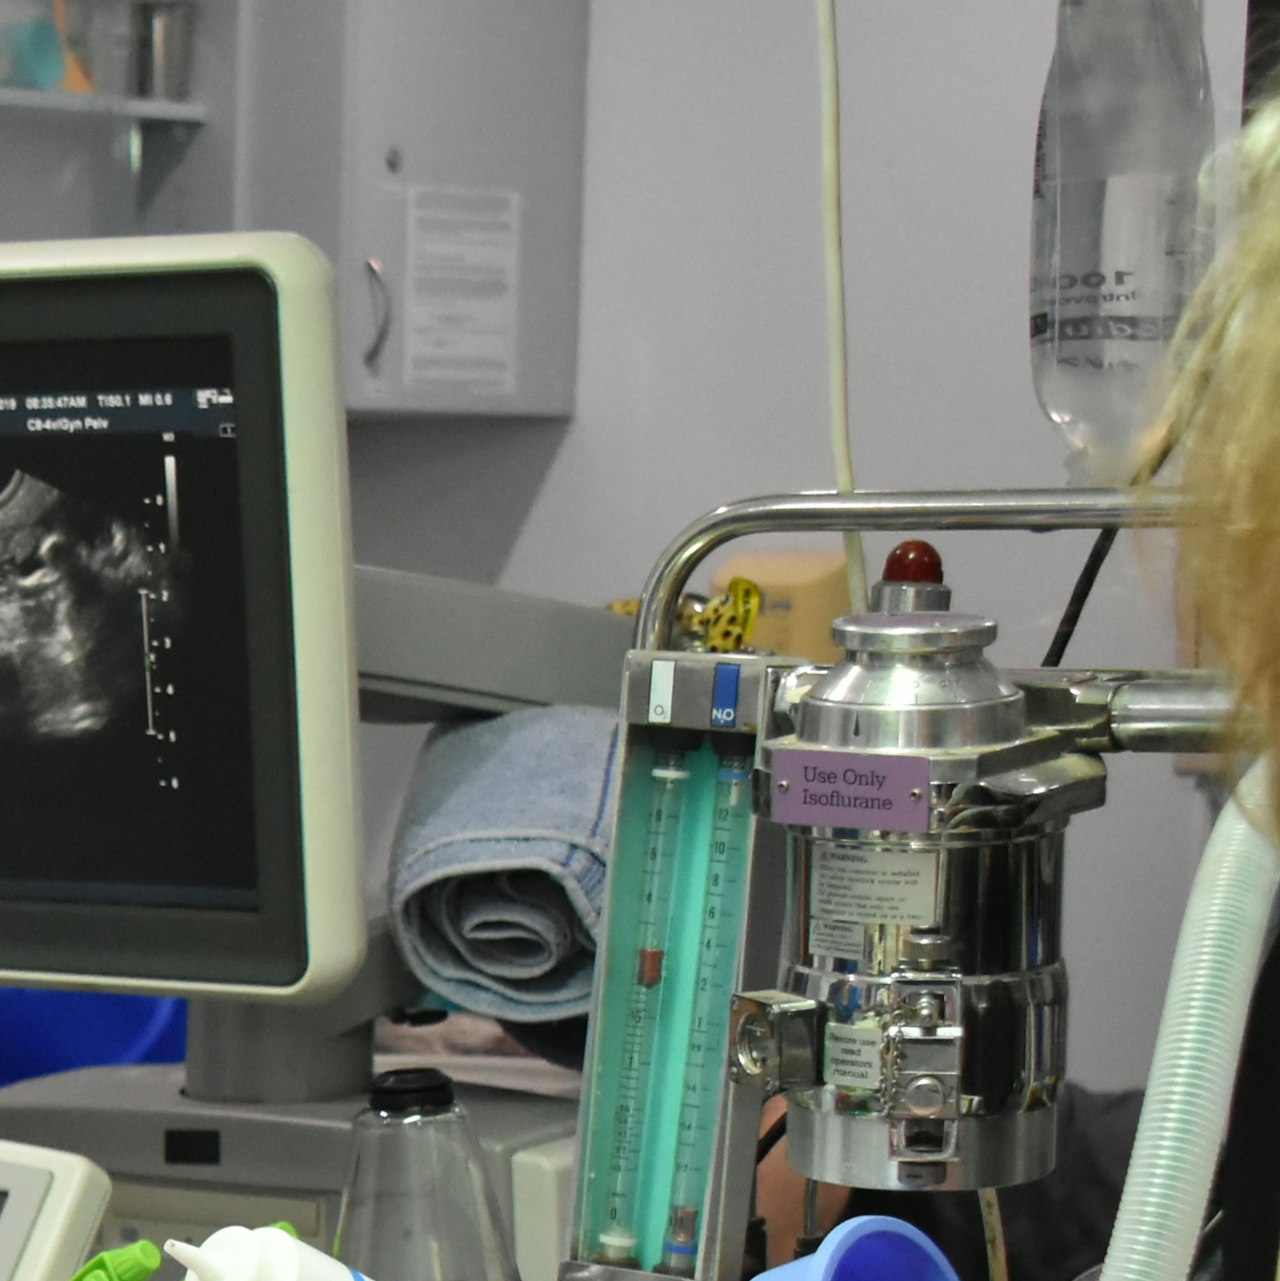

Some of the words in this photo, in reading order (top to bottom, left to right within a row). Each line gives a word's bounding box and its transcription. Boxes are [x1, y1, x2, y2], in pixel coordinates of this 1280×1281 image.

[803, 766, 838, 784] Use
[842, 768, 887, 791] Only
[802, 788, 893, 811] Isoflurane
